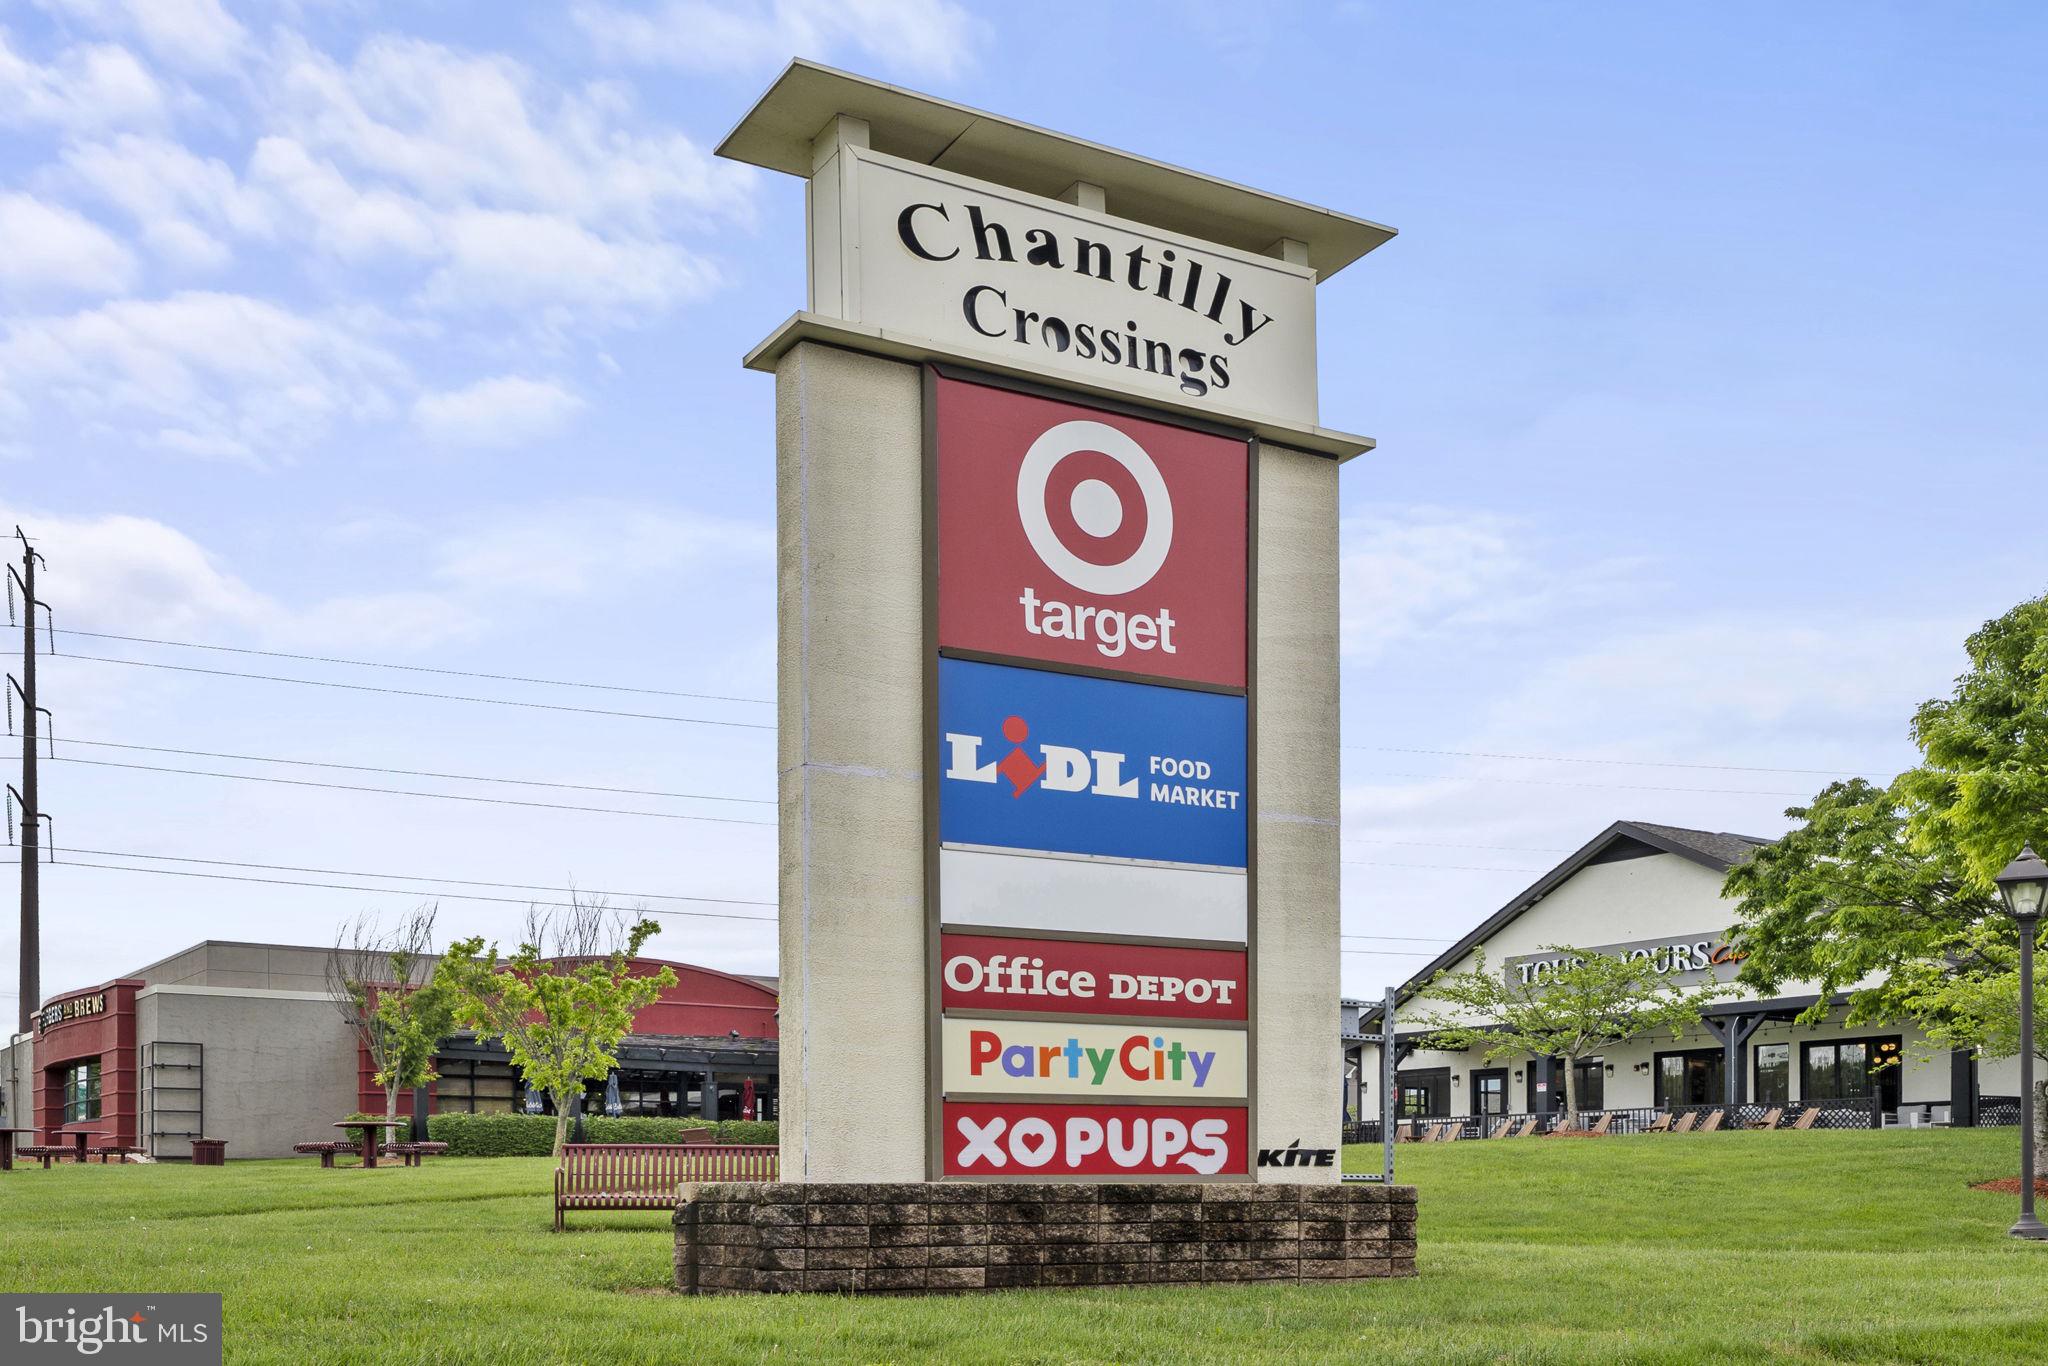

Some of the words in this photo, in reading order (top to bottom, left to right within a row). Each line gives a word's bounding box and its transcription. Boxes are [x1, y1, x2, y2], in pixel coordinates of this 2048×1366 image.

[897, 202, 1274, 346] Chantilly
[962, 284, 1230, 397] Crossings
[1019, 587, 1177, 657] target
[1150, 755, 1211, 780] FOOD
[1150, 782, 1240, 810] MARKET
[943, 955, 1096, 998] Office
[1109, 974, 1236, 1005] DEPOT
[74, 994, 104, 1017] BREWS
